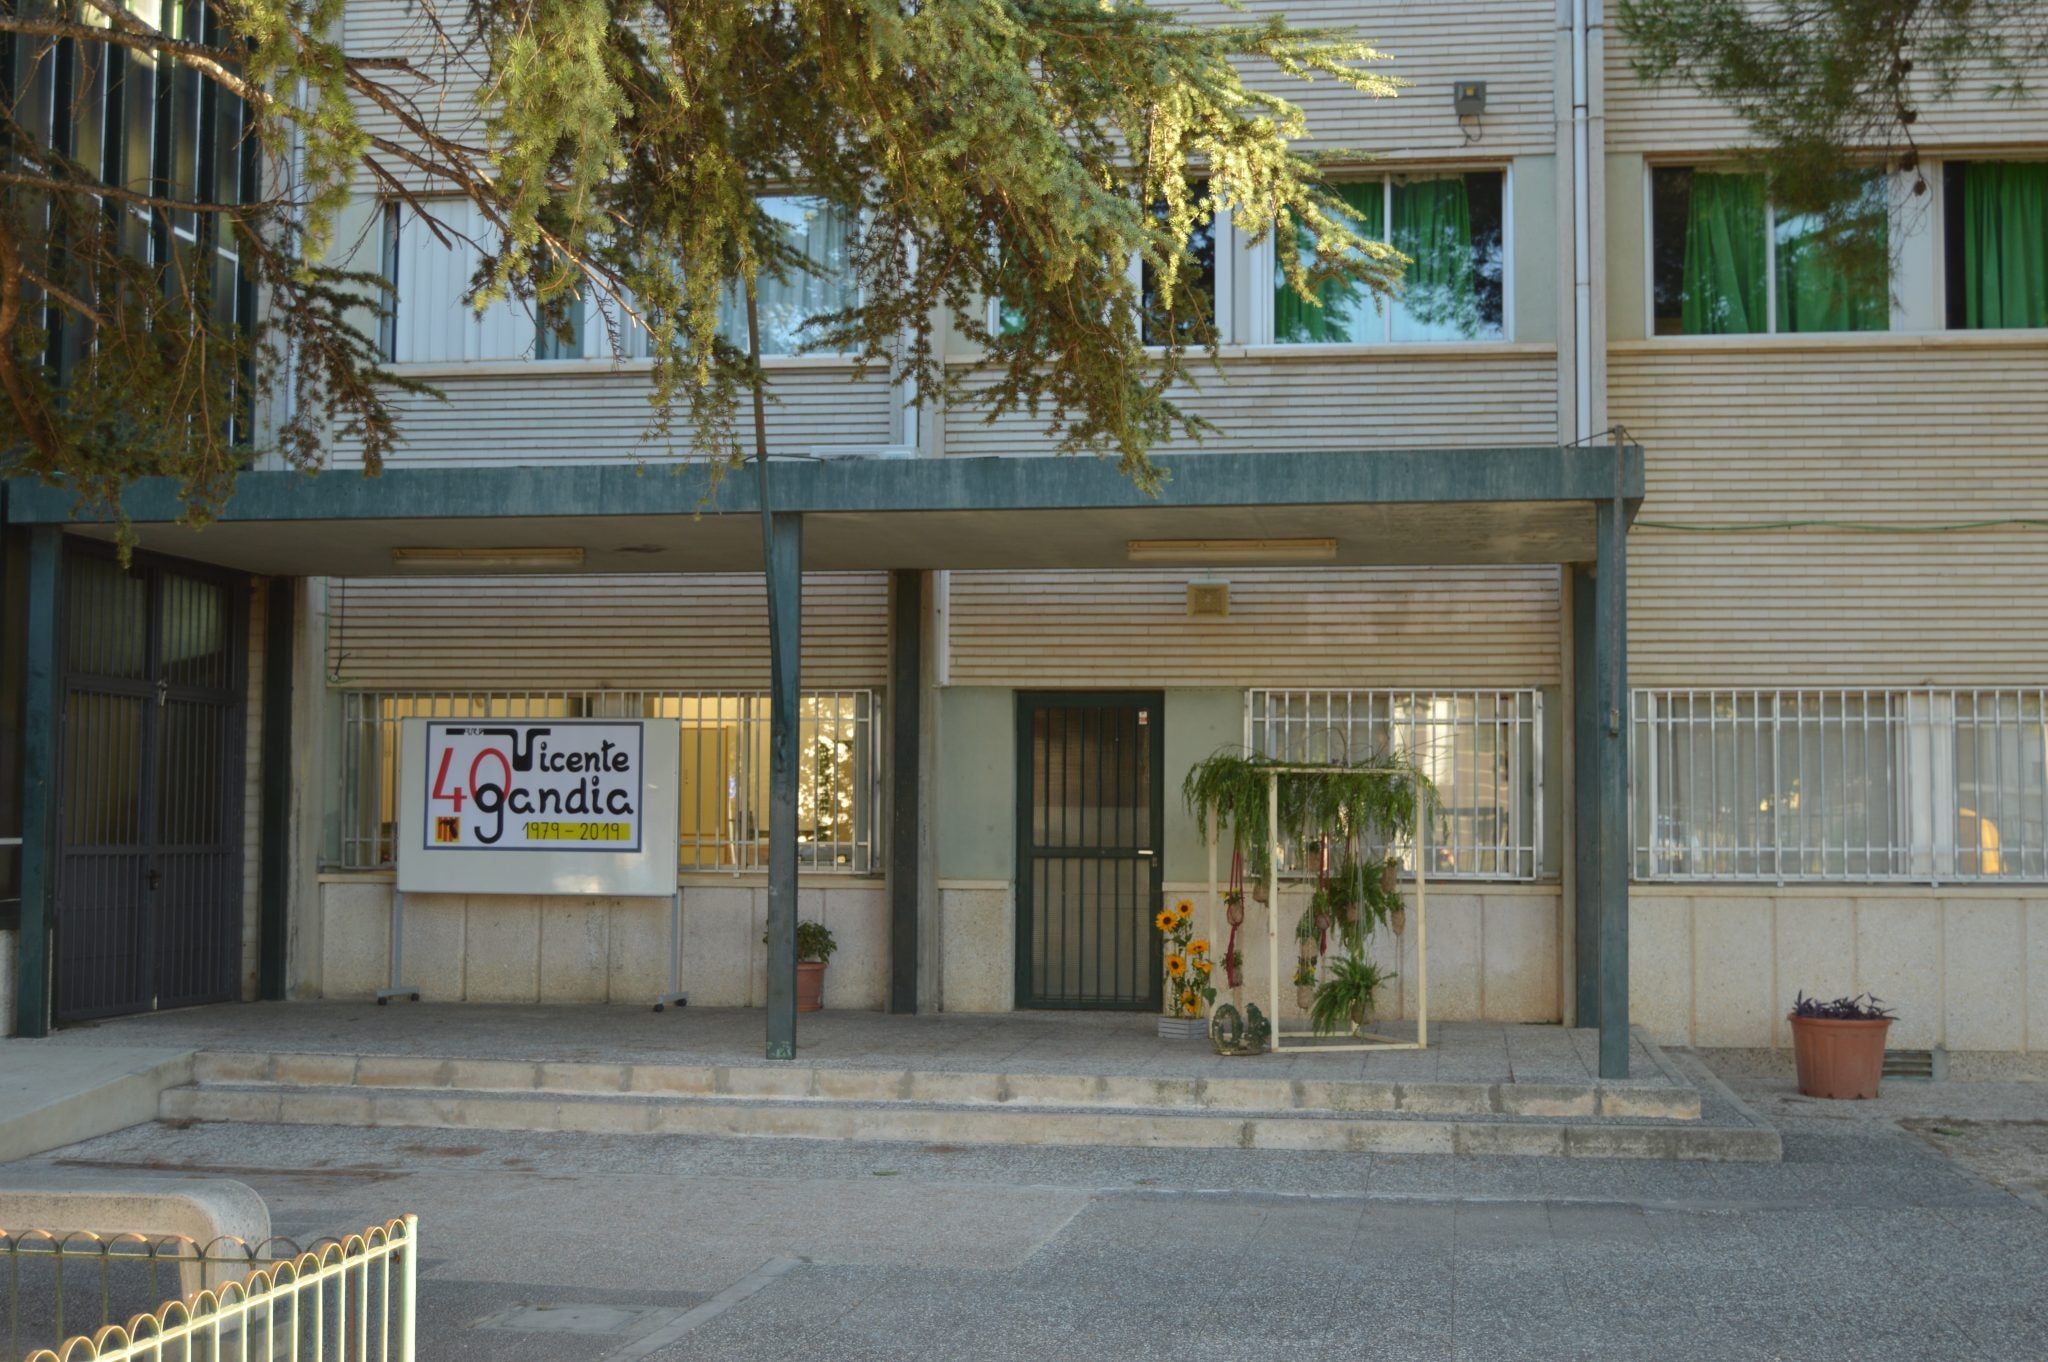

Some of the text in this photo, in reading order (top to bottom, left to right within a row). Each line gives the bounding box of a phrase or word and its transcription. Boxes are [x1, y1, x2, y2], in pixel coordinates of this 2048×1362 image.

[432, 747, 511, 812] 40
[522, 822, 560, 840] 1979
[580, 822, 620, 841] 2019
